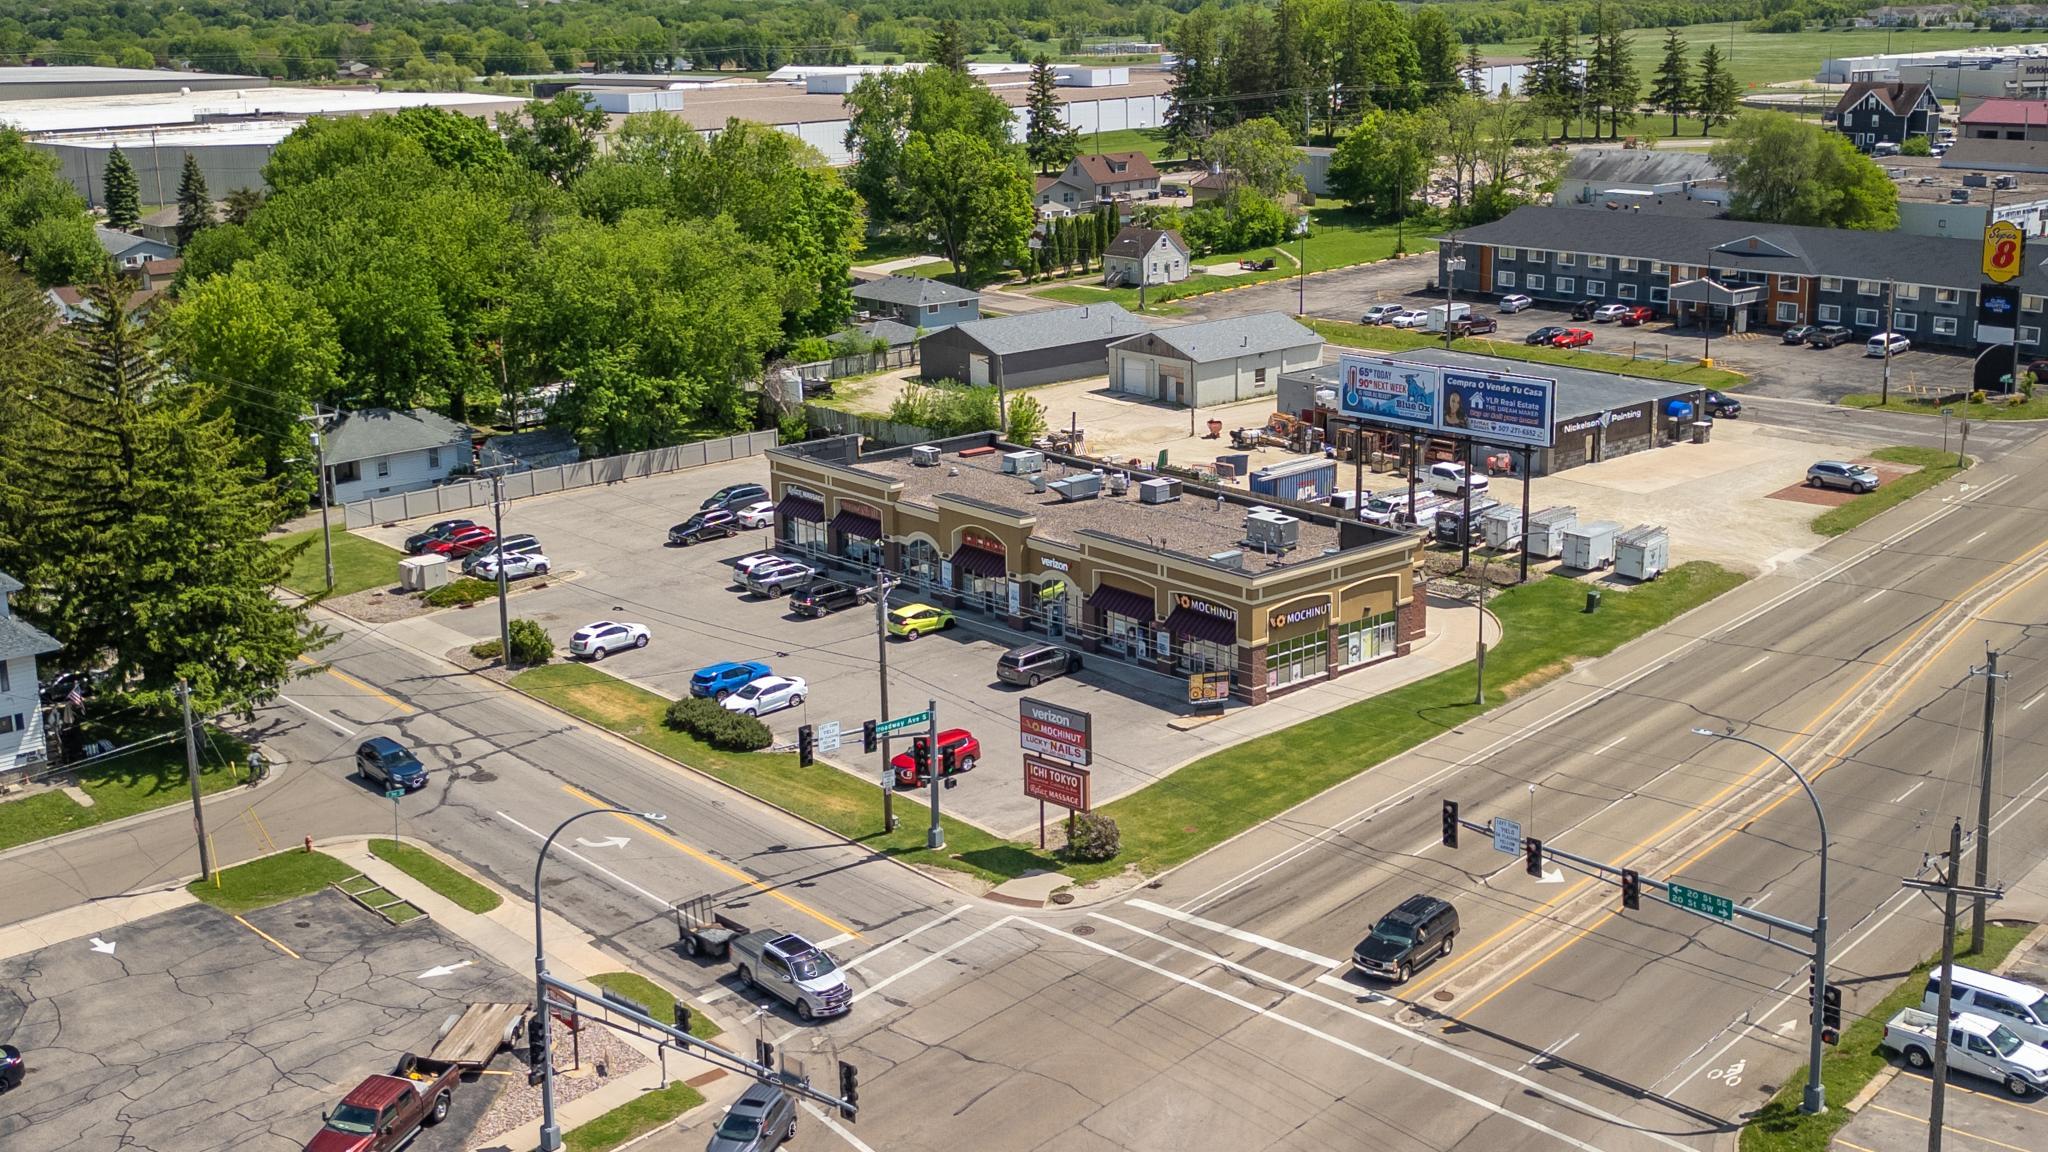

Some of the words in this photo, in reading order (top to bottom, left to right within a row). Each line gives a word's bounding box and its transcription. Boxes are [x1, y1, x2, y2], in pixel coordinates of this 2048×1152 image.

[1989, 227, 2017, 245] Super
[1992, 240, 2017, 268] 8
[1373, 370, 1392, 380] TODAY
[1373, 381, 1389, 390] NEXT
[1390, 384, 1407, 393] WEEK
[1447, 377, 1477, 389] Compra
[1478, 381, 1485, 389] O
[1486, 382, 1511, 392] Vende
[1512, 386, 1522, 394] Tu
[1523, 388, 1543, 397] Casa
[1396, 399, 1416, 410] Blue
[1418, 403, 1430, 412] Ox
[1485, 396, 1499, 405] YLR
[1500, 398, 1516, 407] Real
[1516, 401, 1540, 410] Estate
[1563, 419, 1600, 434] Nickelson
[1611, 409, 1642, 422] Painting
[1296, 485, 1318, 501] APL
[1041, 556, 1069, 571] verizon
[1191, 600, 1238, 621] MOCHINUT
[1287, 602, 1332, 624] MOCHINUT
[877, 720, 905, 733] roadway
[907, 716, 920, 724] Ave
[1031, 708, 1070, 727] verizon
[1041, 724, 1082, 744] MOCHINUT
[1025, 735, 1049, 748] LUCKY
[1050, 740, 1082, 758] NAILS
[1030, 764, 1048, 780] ICHI
[1049, 770, 1078, 788] TOKYO
[1048, 790, 1078, 805] MASSAGE
[1672, 894, 1684, 904] 20
[1687, 899, 1697, 908] St
[1701, 903, 1714, 913] SW
[1686, 890, 1699, 900] 20
[1702, 894, 1712, 903] St
[1716, 898, 1729, 908] SE
